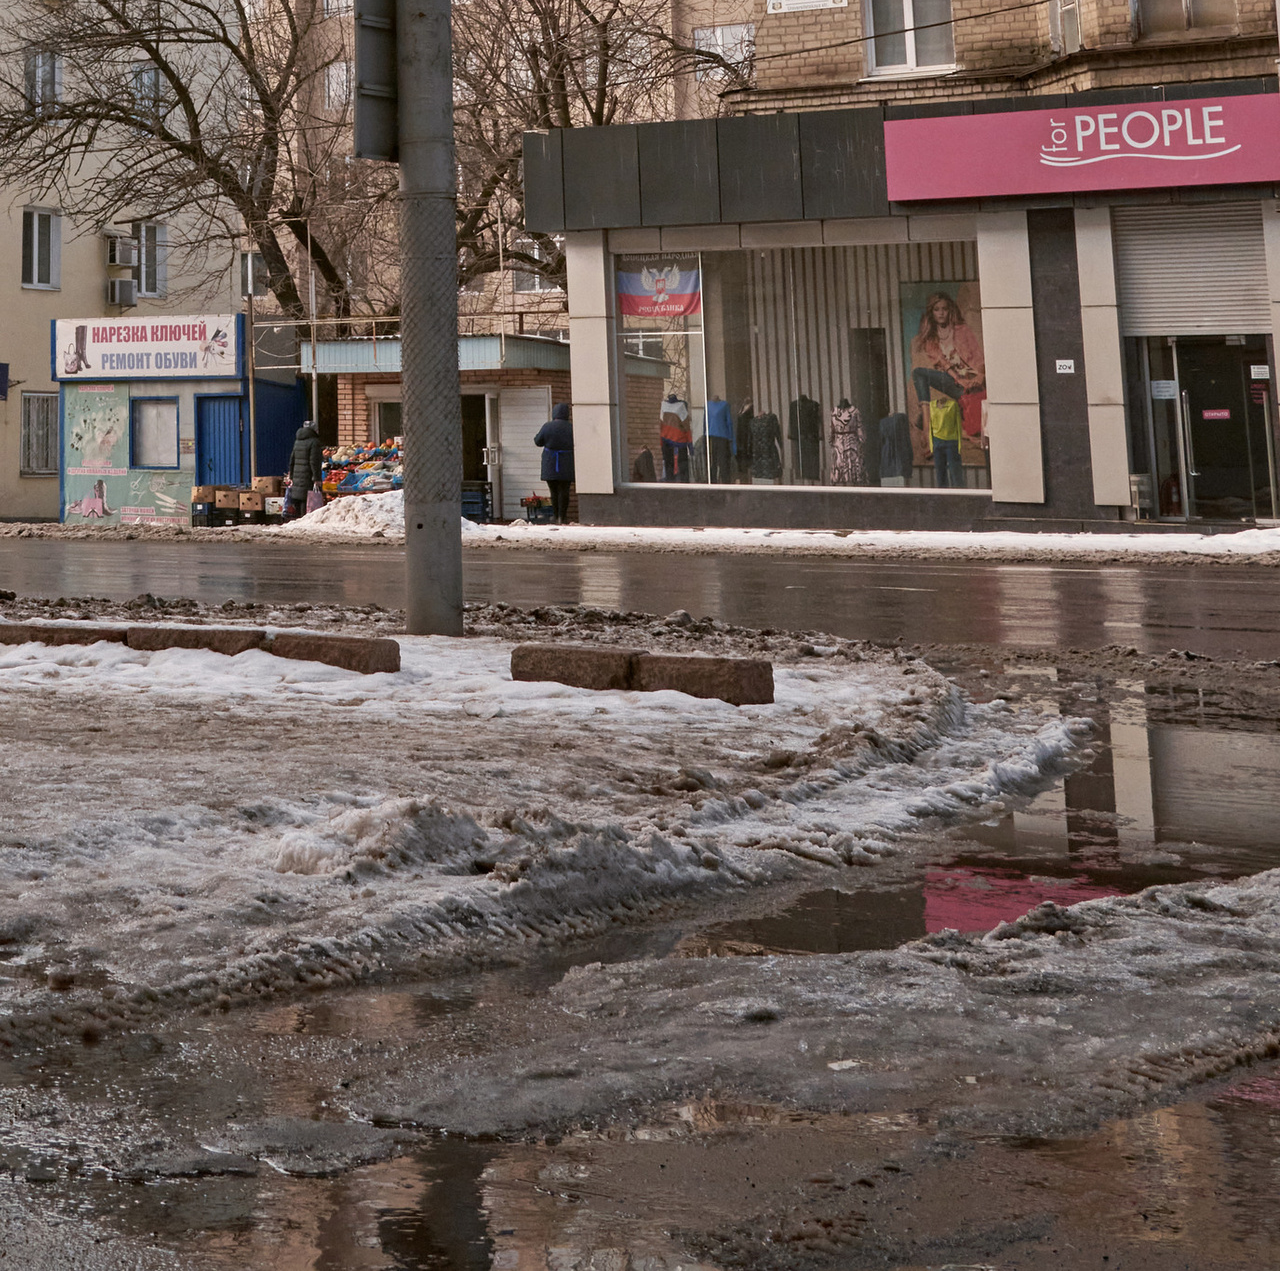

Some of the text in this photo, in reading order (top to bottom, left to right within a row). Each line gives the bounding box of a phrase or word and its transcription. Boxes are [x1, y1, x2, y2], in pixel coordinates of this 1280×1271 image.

[1041, 105, 1226, 152] for PEOPLE
[92, 320, 207, 343] НАРЕЗКА КЛЮЧЕЙ
[101, 351, 197, 370] РЕМОНТ ОБУВИ
